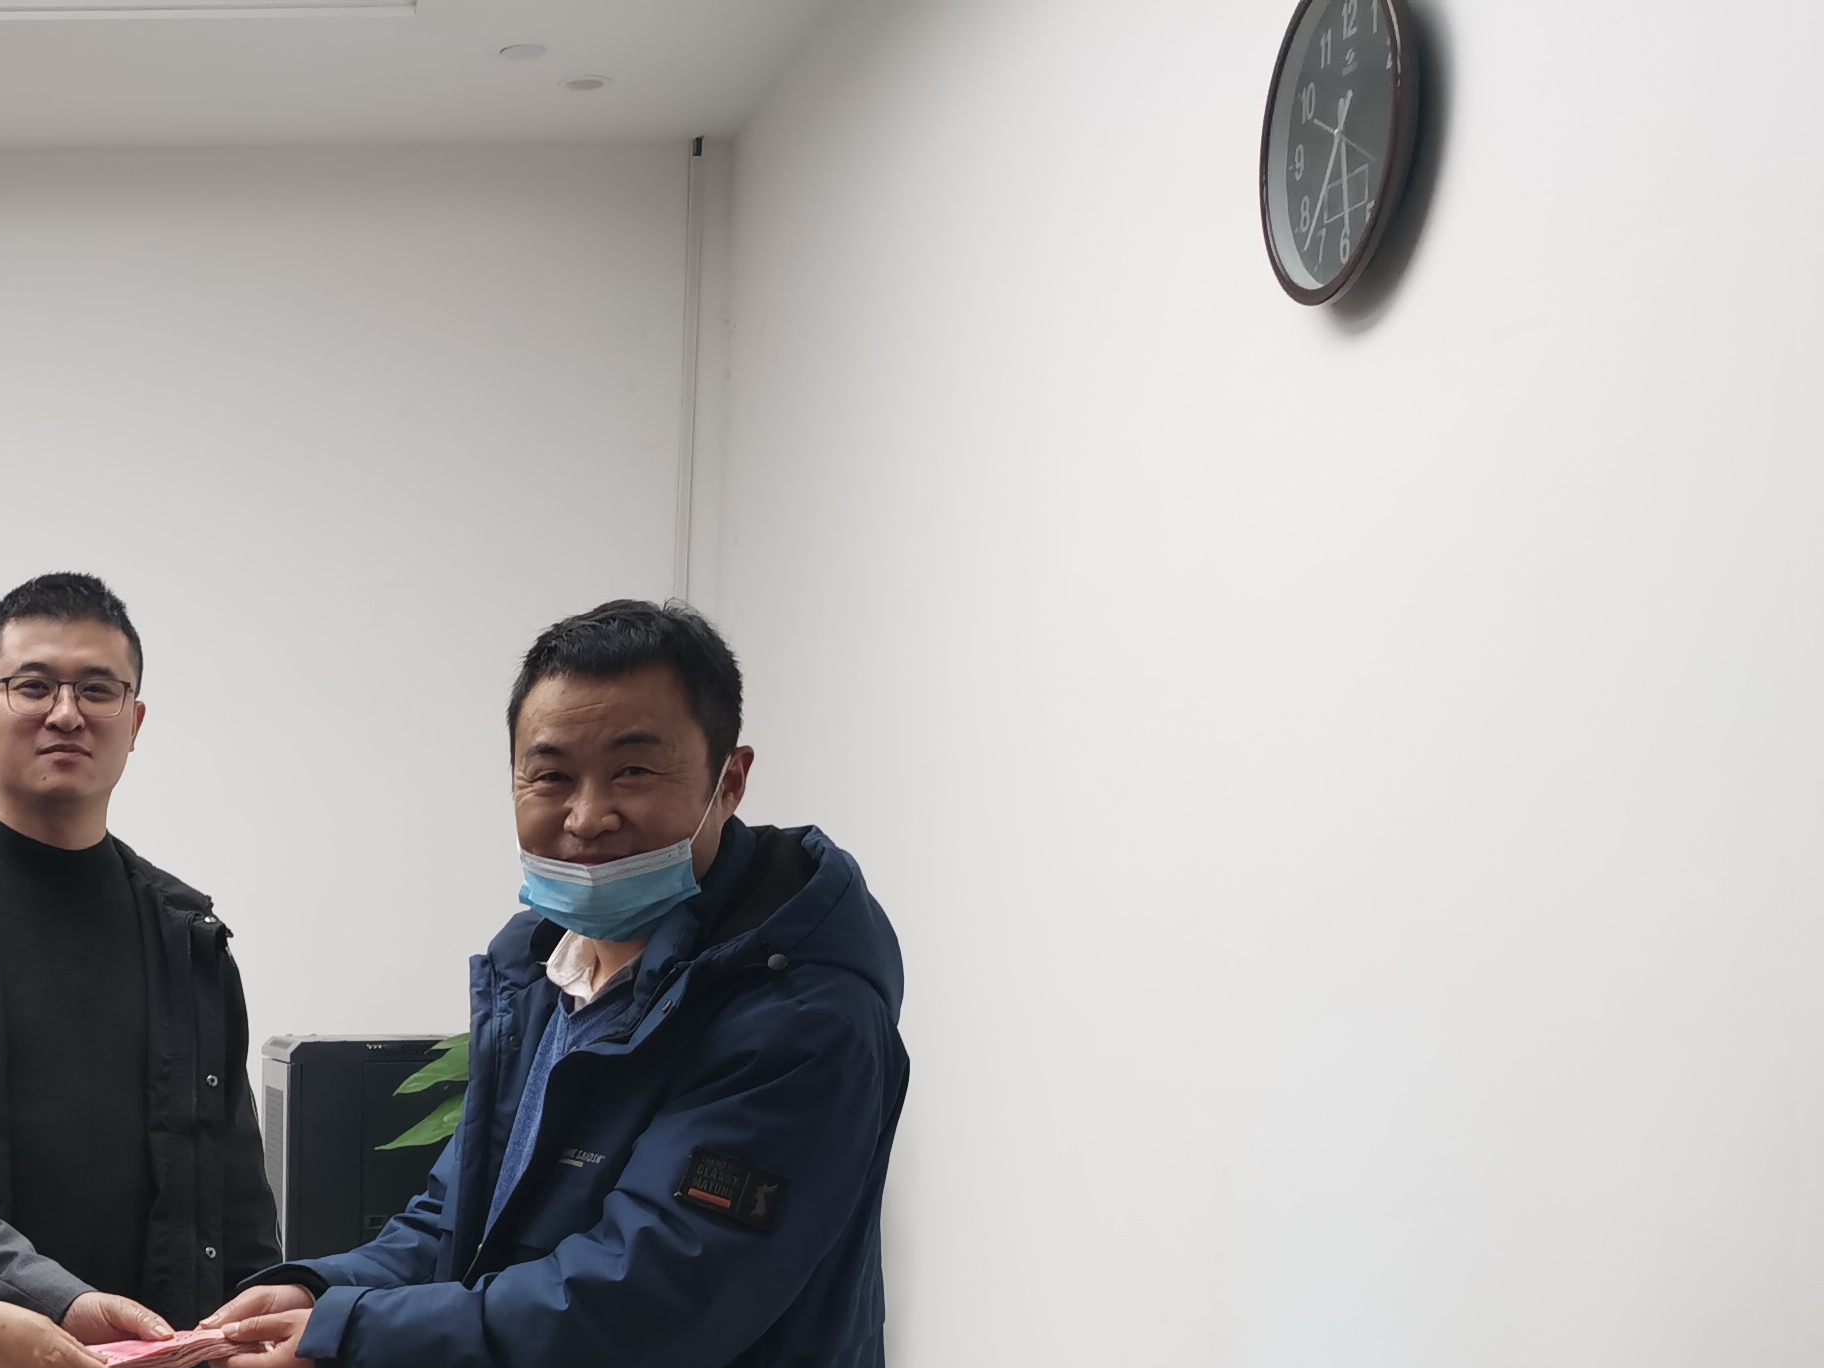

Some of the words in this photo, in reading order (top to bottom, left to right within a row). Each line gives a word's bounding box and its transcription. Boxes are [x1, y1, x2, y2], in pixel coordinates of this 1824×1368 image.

[1319, 28, 1332, 69] 11
[1299, 82, 1316, 124] 10
[1293, 144, 1305, 181] 9
[1299, 195, 1311, 233] 8
